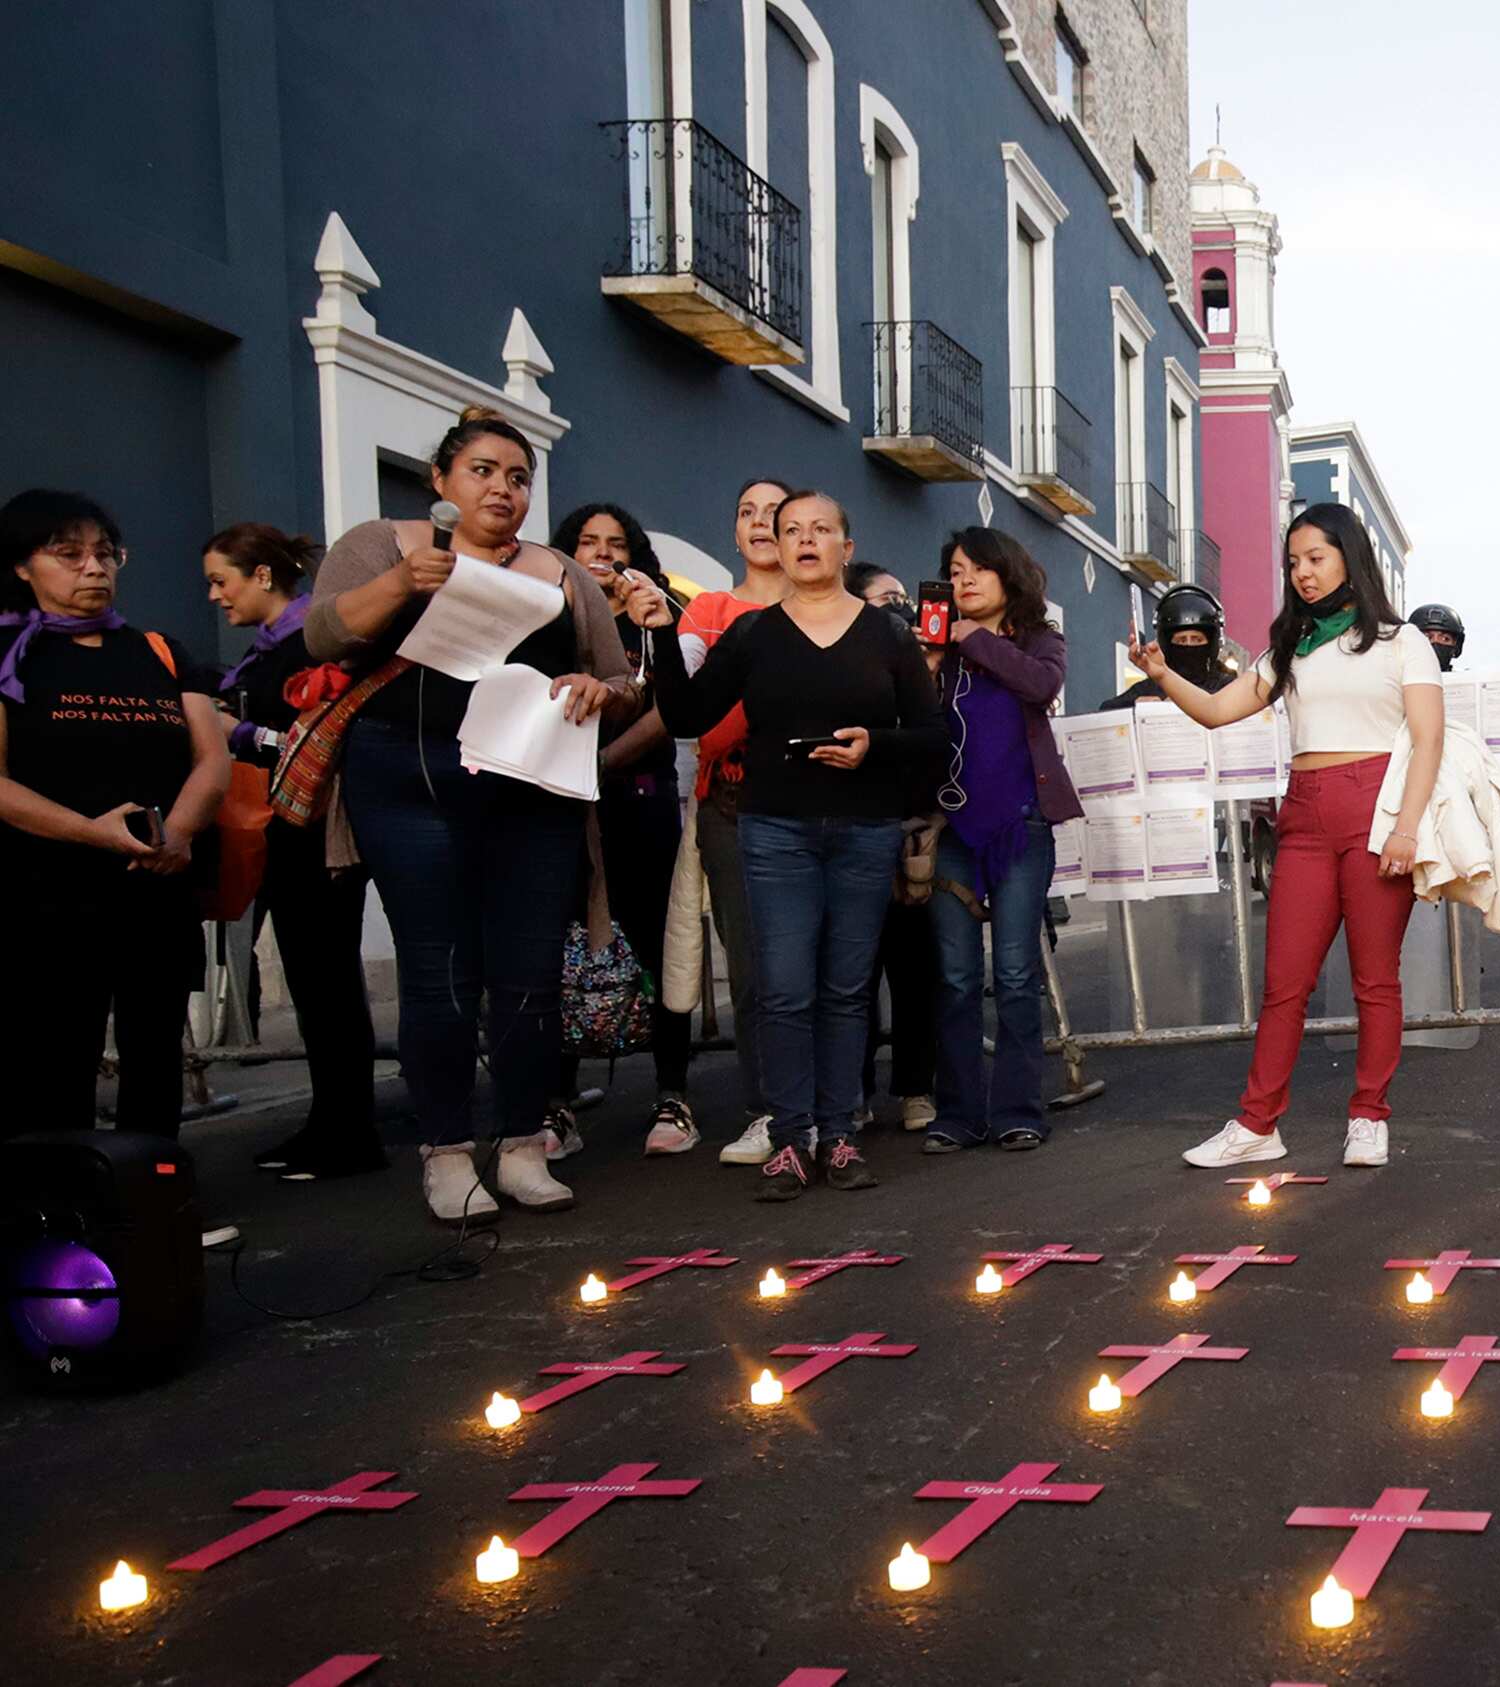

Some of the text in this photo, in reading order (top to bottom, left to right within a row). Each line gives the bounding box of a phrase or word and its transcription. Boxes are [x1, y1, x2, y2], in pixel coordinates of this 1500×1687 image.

[61, 694, 94, 704] NOS
[99, 695, 149, 707] FALTA
[52, 710, 87, 720] NOS
[91, 711, 157, 722] FALTAN
[565, 1484, 635, 1493] Antonia
[964, 1485, 1051, 1497] Olga Lidia
[1349, 1512, 1424, 1523] Marcela
